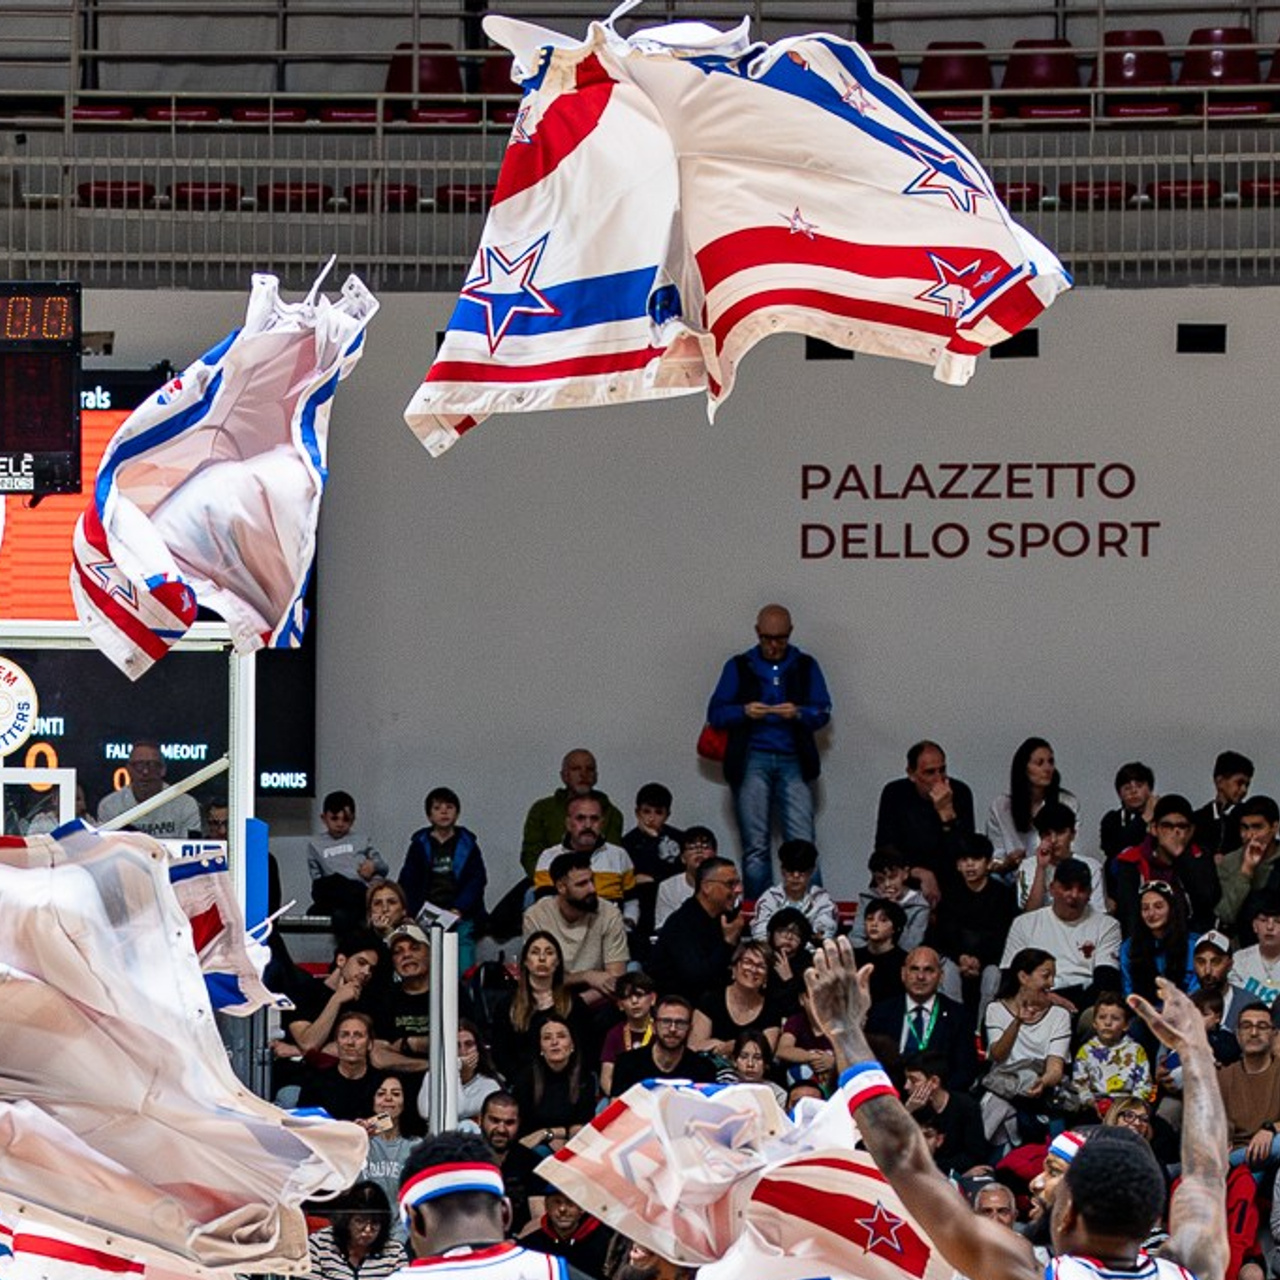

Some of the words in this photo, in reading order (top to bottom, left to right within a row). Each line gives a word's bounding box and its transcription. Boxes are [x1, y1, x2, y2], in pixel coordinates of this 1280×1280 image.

[81, 387, 111, 409] rals
[801, 463, 1136, 500] PALAZZETTO
[801, 522, 970, 559] DELLO
[986, 521, 1161, 558] SPORT
[31, 717, 64, 736] UNTI
[161, 744, 208, 760] MEOUT
[260, 772, 307, 788] BONUS
